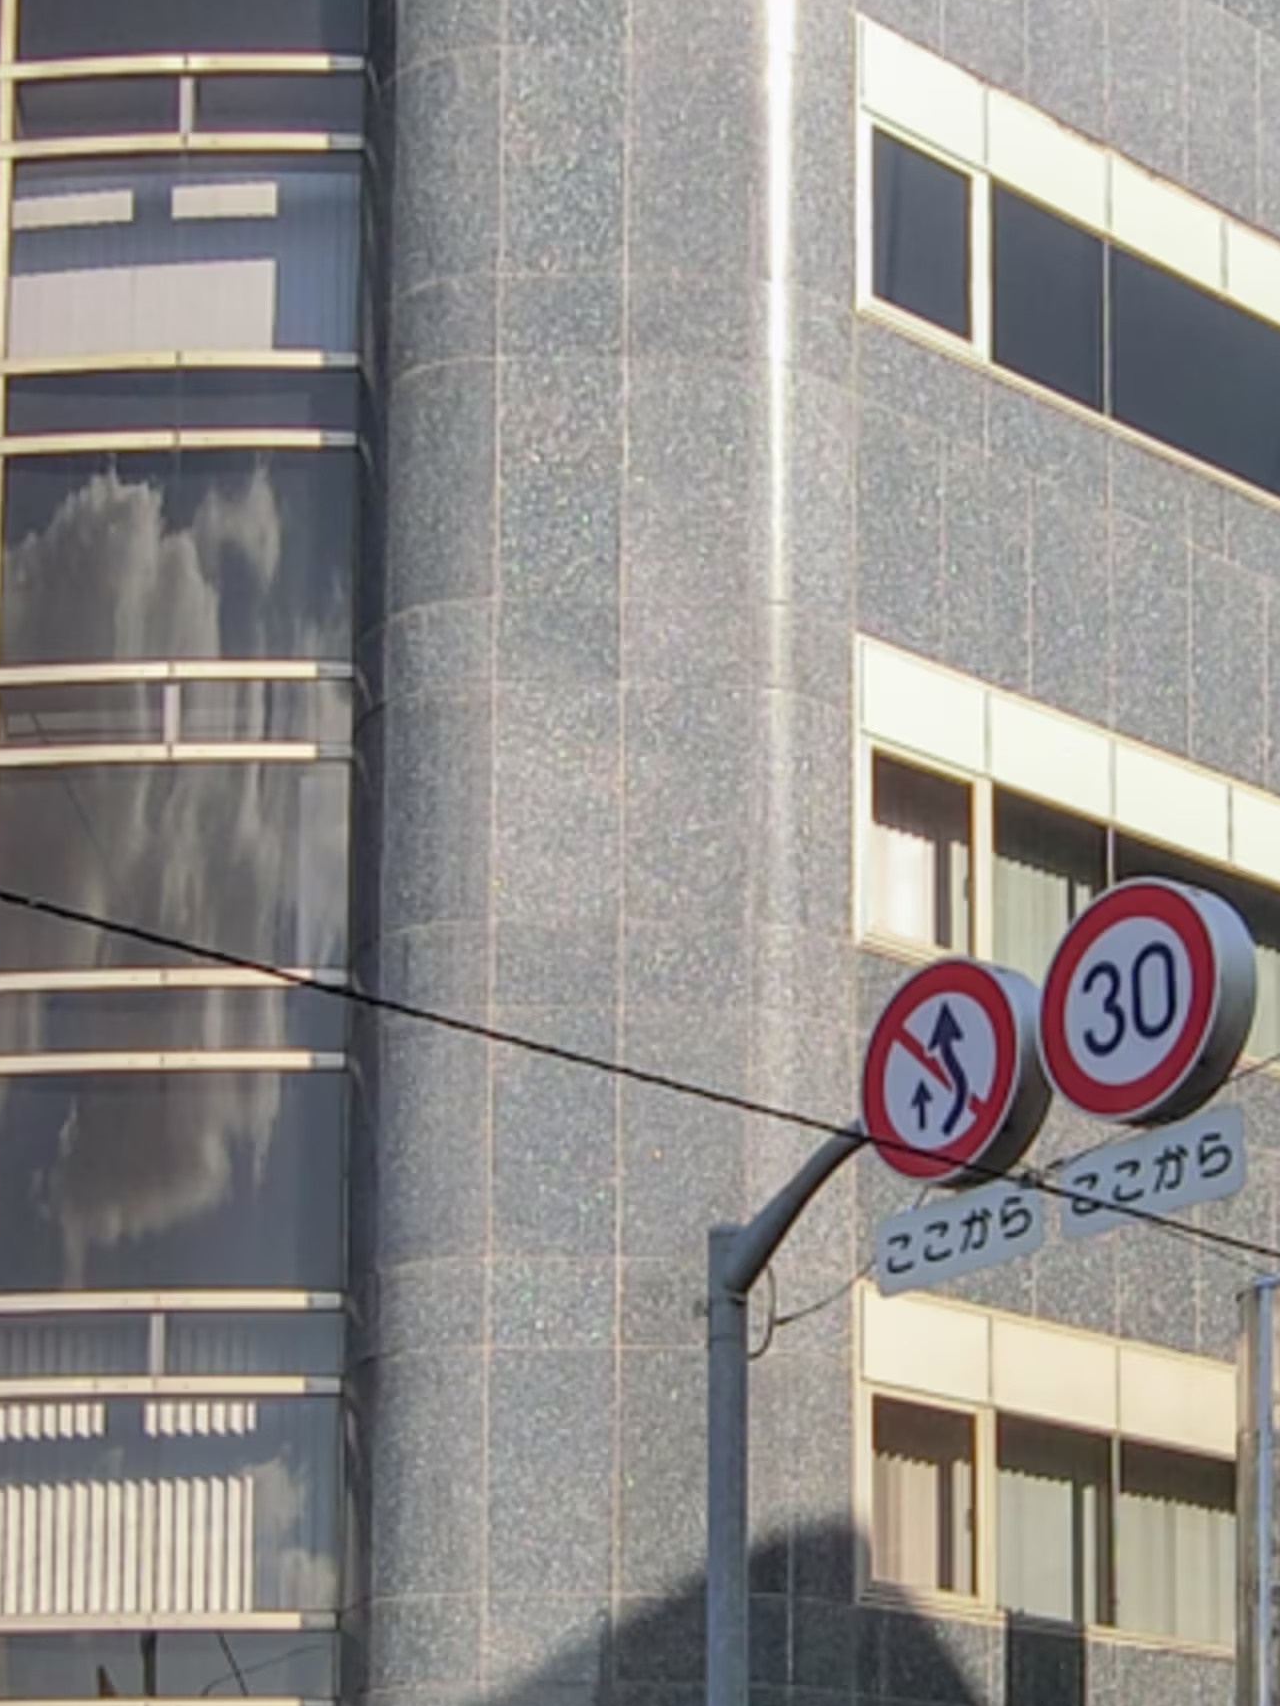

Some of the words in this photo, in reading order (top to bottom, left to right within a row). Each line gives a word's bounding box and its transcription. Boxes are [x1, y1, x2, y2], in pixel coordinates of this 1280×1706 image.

[1082, 940, 1177, 1057] 30
[1072, 1131, 1233, 1216] ここから
[887, 1196, 1033, 1274] ここから
